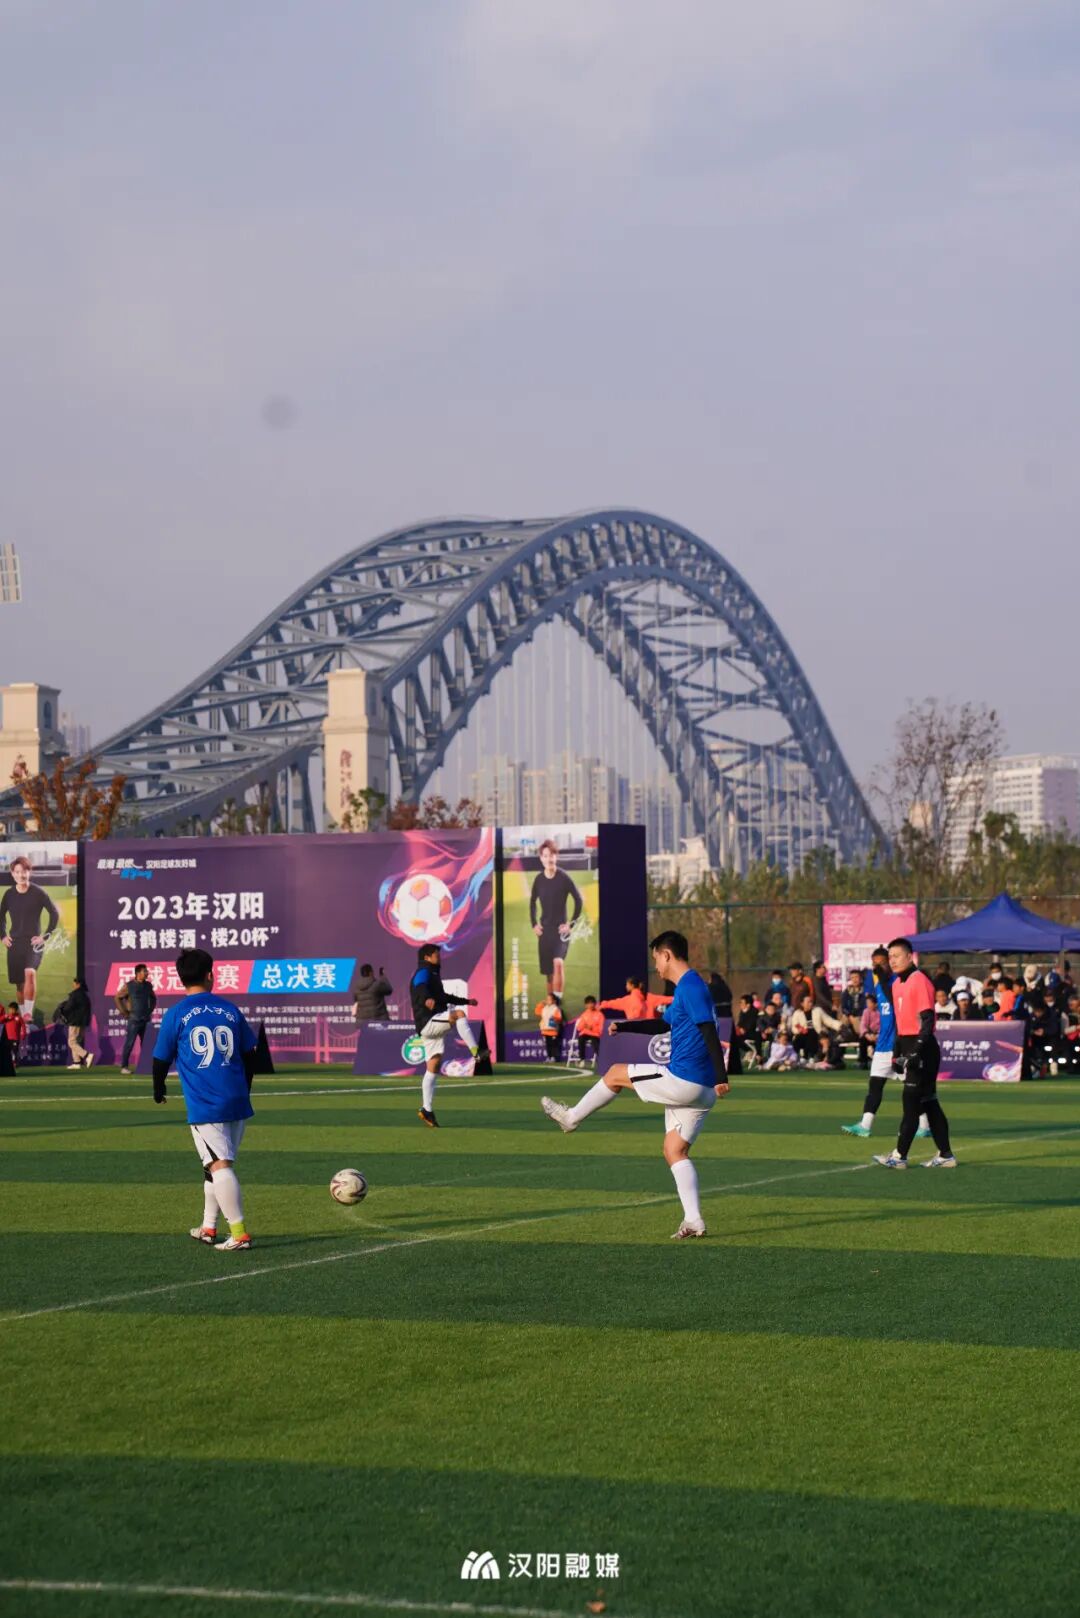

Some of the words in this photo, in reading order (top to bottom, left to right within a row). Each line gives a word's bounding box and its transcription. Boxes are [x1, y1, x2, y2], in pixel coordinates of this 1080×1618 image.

[117, 892, 265, 921] 2023年汉阳
[117, 964, 240, 991] 足球冠赛
[261, 963, 336, 990] 总决赛
[190, 1025, 234, 1069] 99
